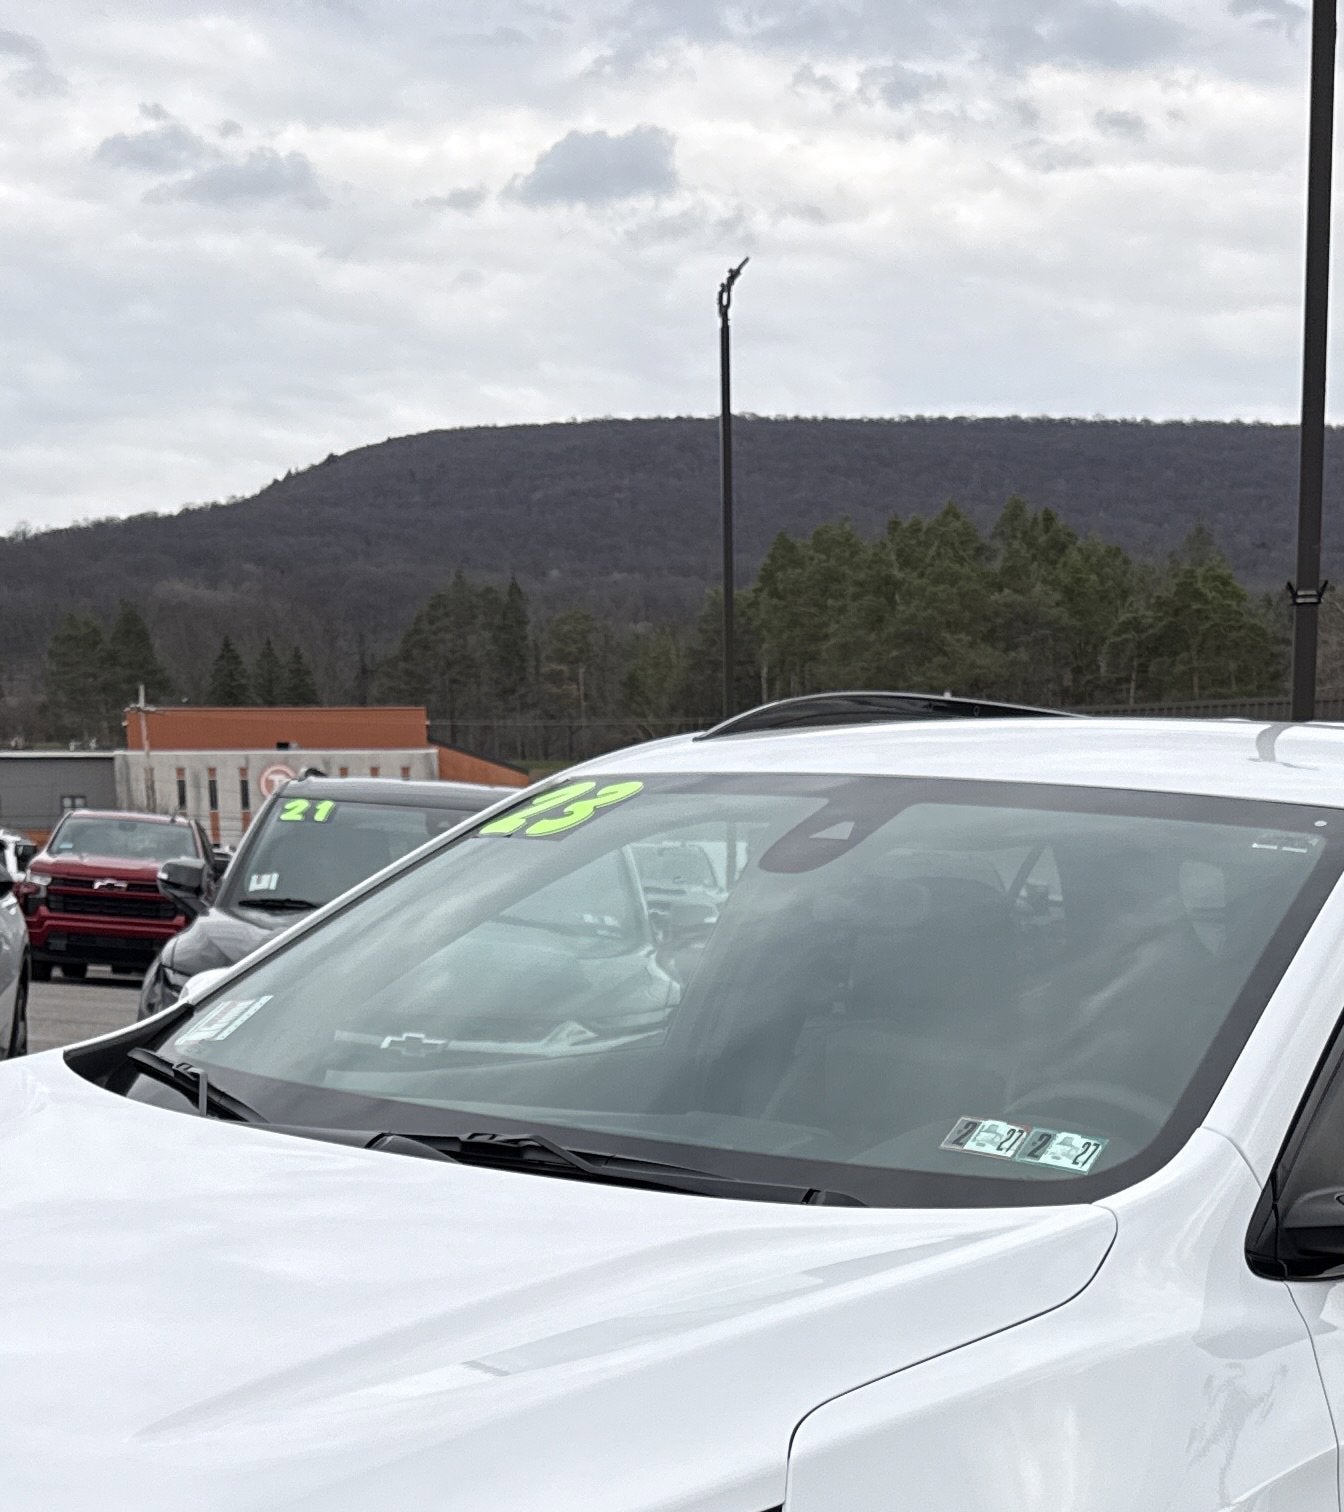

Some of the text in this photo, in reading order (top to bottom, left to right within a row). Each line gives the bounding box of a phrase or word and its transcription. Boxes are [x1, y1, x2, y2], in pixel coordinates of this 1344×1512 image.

[279, 798, 336, 823] 21
[478, 781, 644, 837] 23
[996, 1128, 1025, 1153] 27
[1071, 1141, 1101, 1166] 27
